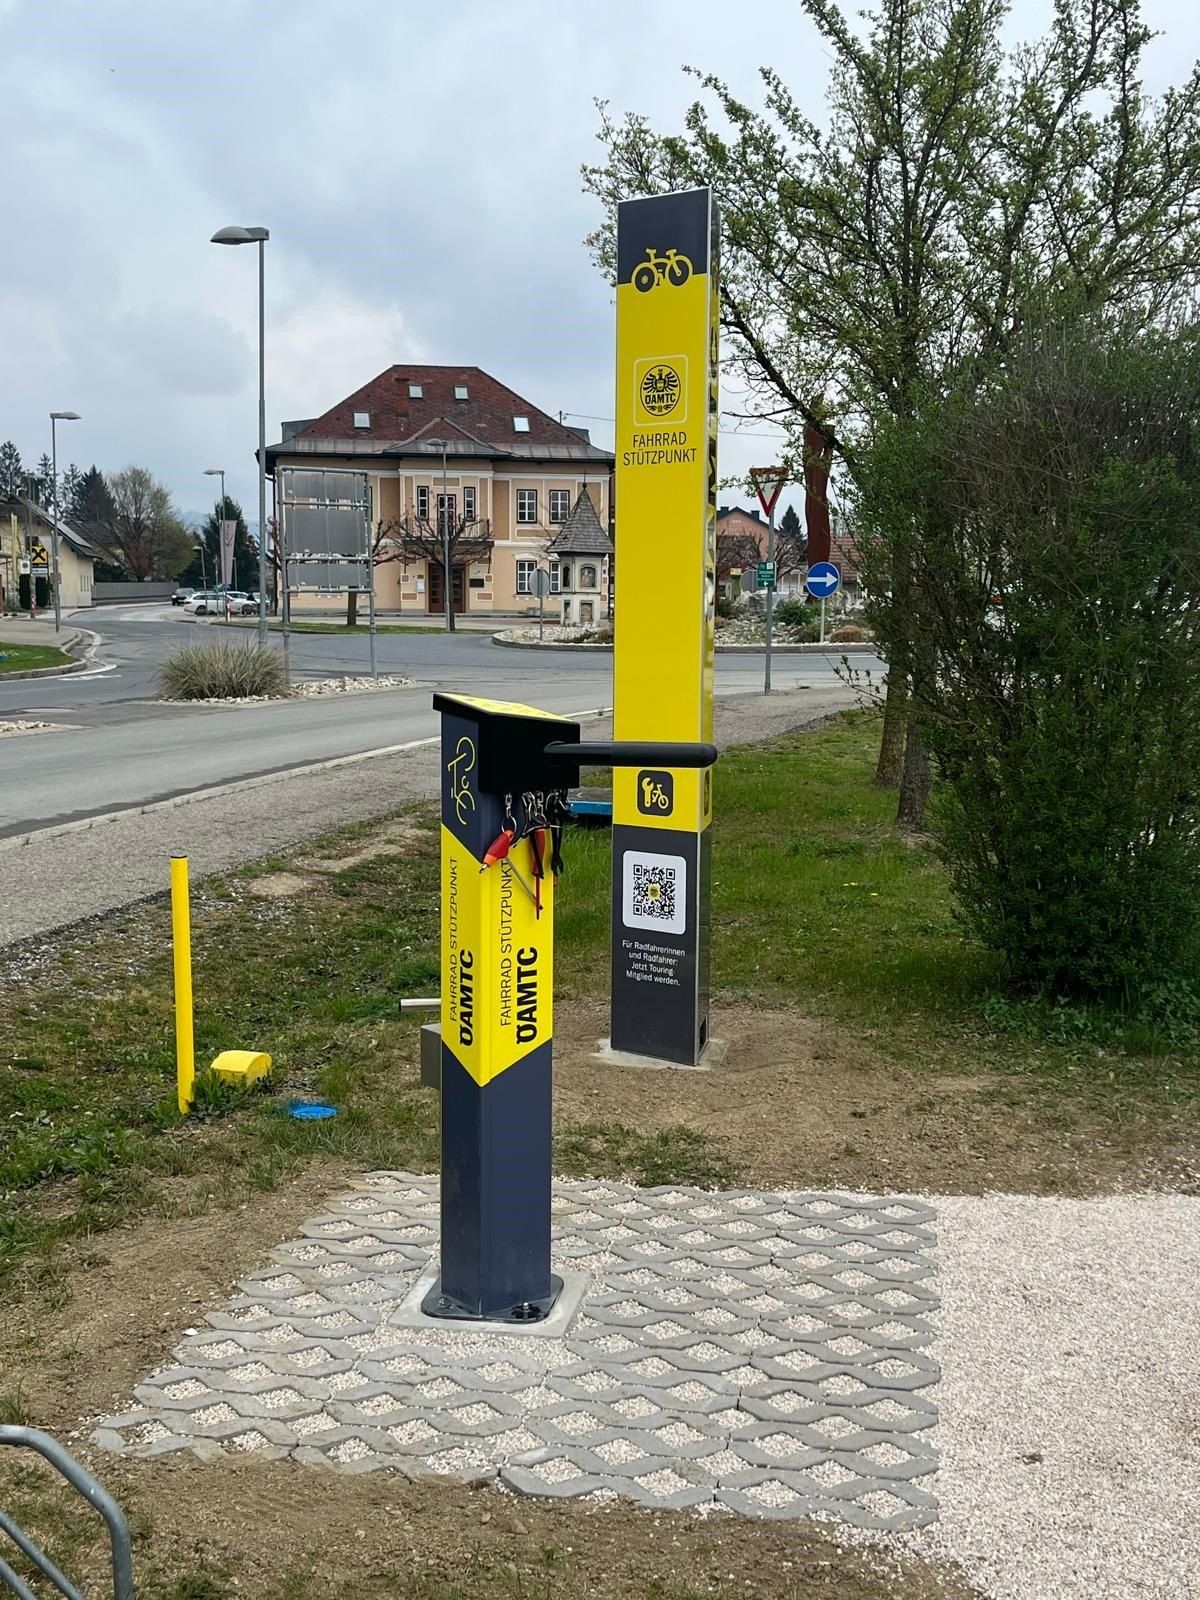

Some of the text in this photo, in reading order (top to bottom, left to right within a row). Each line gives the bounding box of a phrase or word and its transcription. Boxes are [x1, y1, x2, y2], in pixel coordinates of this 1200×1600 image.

[633, 432, 687, 448] FAHRRAD
[623, 448, 697, 466] STÜTZPUNKT
[448, 857, 458, 1021] FAHRRAD STÜTZPUNKT
[498, 859, 513, 1026] FAHRRAD STÜTZPUNKT
[622, 939, 685, 956] Für Radfahrerinnen
[629, 952, 641, 960] und
[631, 961, 648, 971] Jetzt
[626, 970, 652, 981] Mitglied
